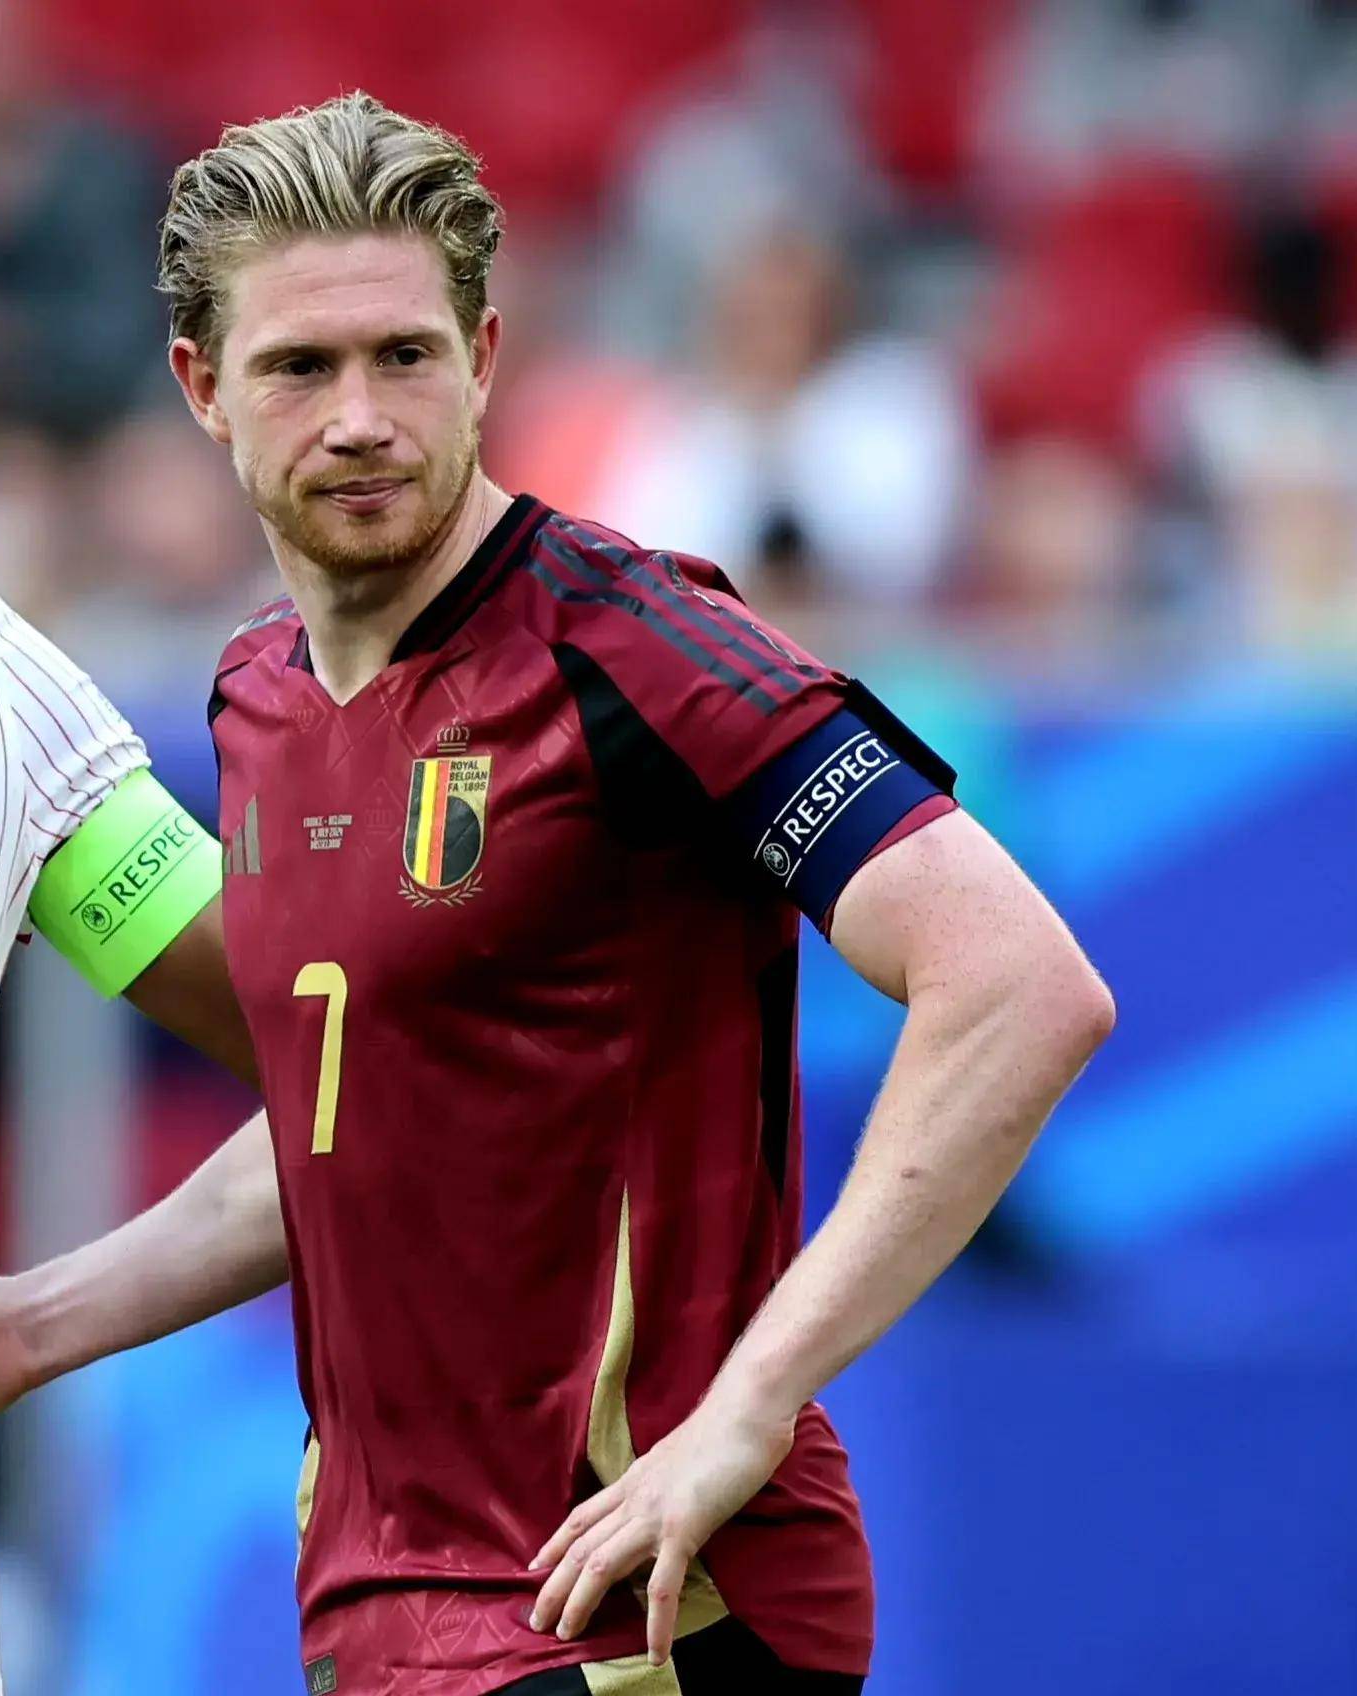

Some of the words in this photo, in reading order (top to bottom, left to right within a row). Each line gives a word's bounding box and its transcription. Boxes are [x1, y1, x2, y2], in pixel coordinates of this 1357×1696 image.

[449, 771, 488, 781] BELGIAN
[450, 761, 478, 770] ROYAL
[464, 782, 486, 791] 1895
[783, 739, 889, 845] RESPECT
[107, 814, 195, 907] RESPEC
[293, 962, 348, 1155] 7
